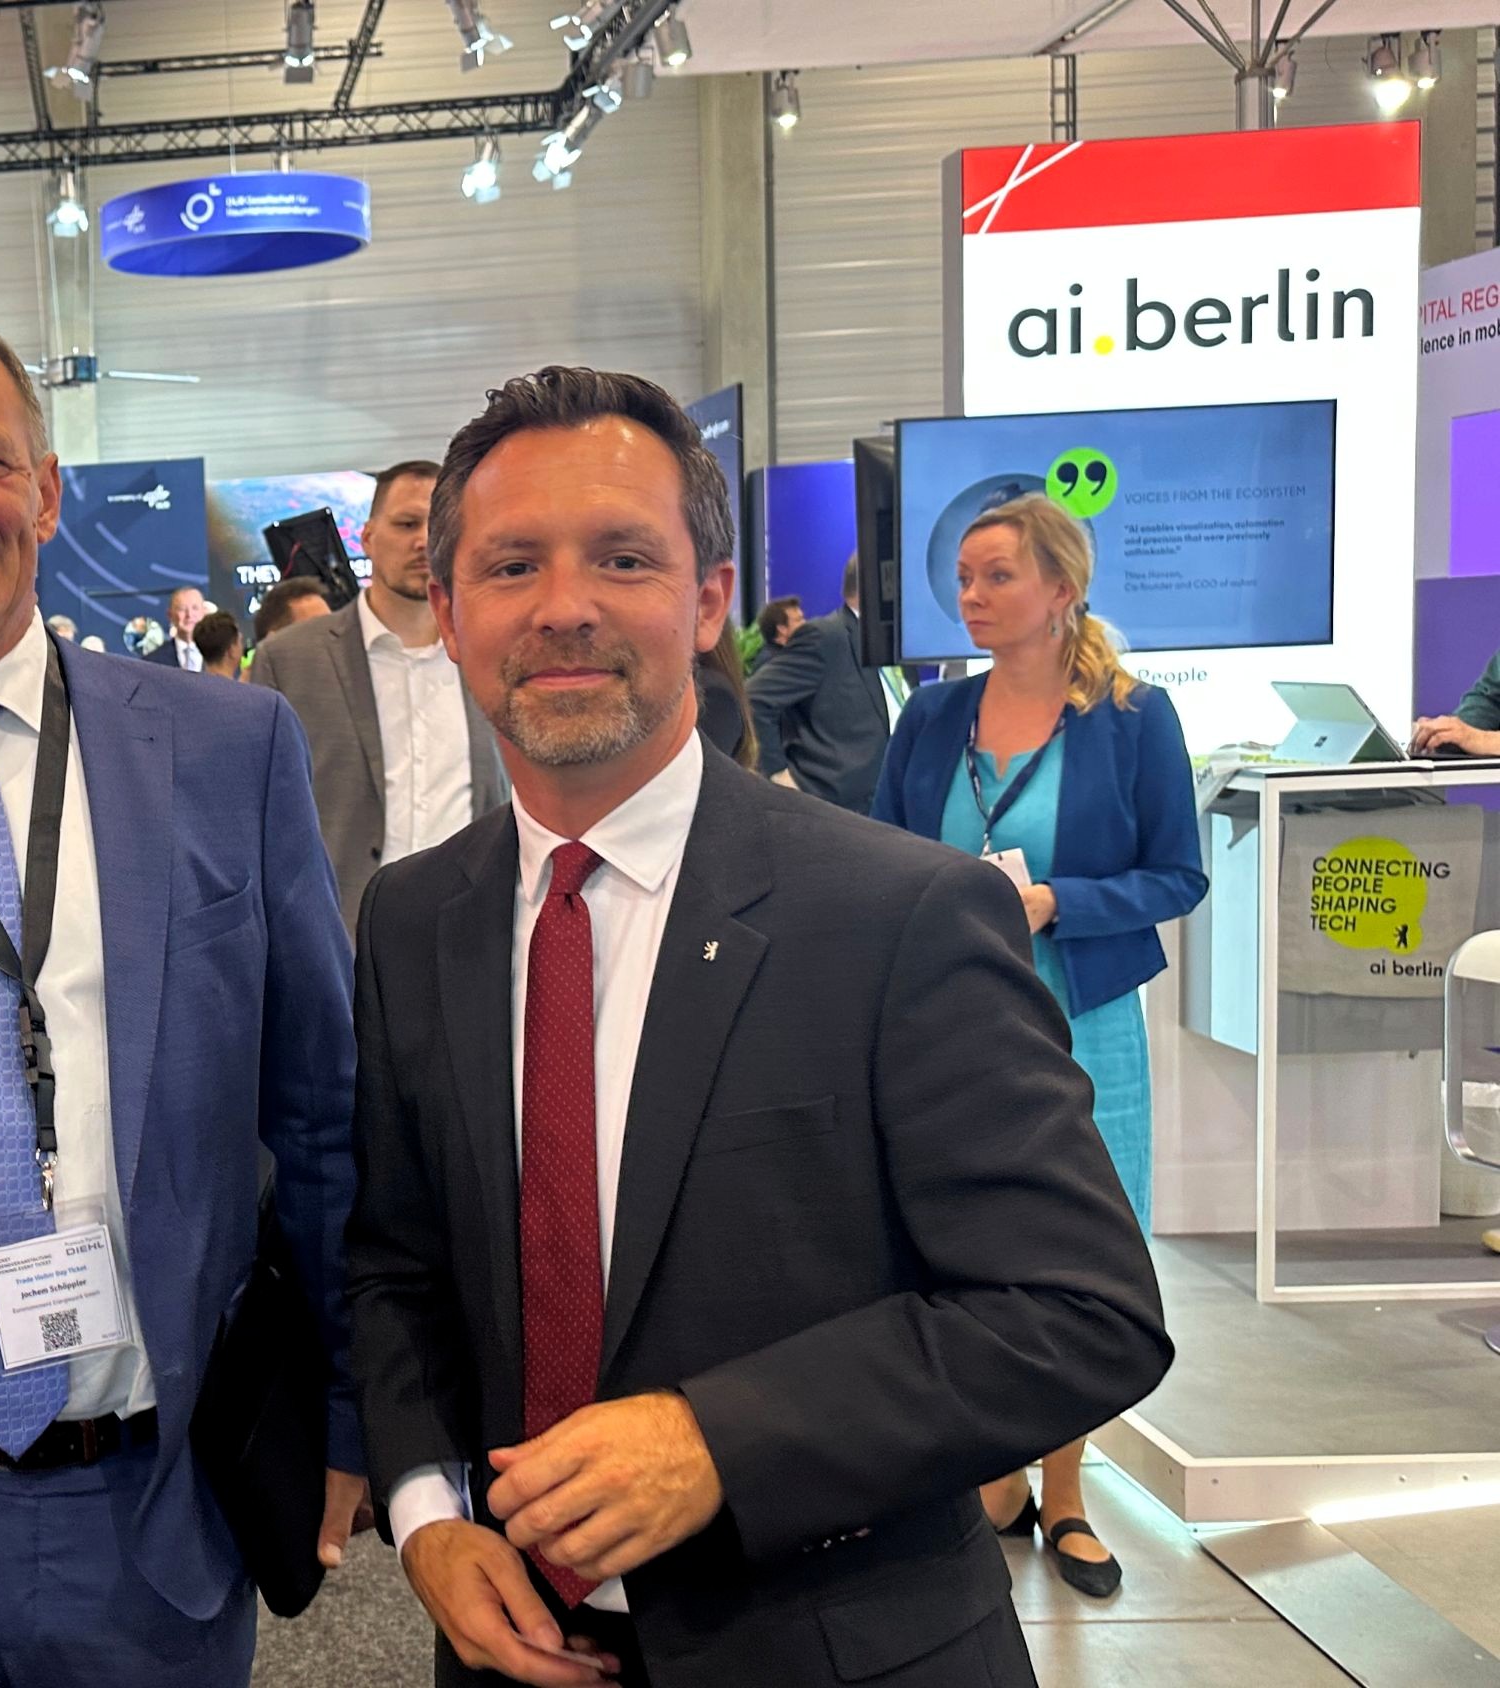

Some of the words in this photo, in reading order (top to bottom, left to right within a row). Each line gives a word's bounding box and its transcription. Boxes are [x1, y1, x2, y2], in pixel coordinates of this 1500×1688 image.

[1462, 284, 1499, 315] REG
[1421, 334, 1455, 355] lence
[1459, 327, 1471, 346] in
[1124, 492, 1170, 505] VOICES
[1173, 490, 1209, 503] FROM
[1211, 488, 1233, 500] THE
[1236, 485, 1306, 499] ECOSYSTEM
[1184, 533, 1202, 542] that
[1204, 534, 1224, 542] were
[1227, 531, 1270, 542] previously
[1138, 667, 1208, 686] People
[1312, 856, 1451, 879] CONNECTING
[1312, 875, 1384, 894] PEOPLE
[1310, 894, 1397, 914] SHAPING
[1310, 914, 1357, 932] TECH
[1370, 959, 1386, 974] ai
[1393, 960, 1443, 977] berlin
[65, 1242, 105, 1256] DIEHL
[15, 1276, 34, 1285] Trade
[55, 1269, 68, 1278] Day
[68, 1265, 87, 1274] Ticket
[21, 1287, 49, 1300] Jochem
[50, 1278, 87, 1294] Schöppler
